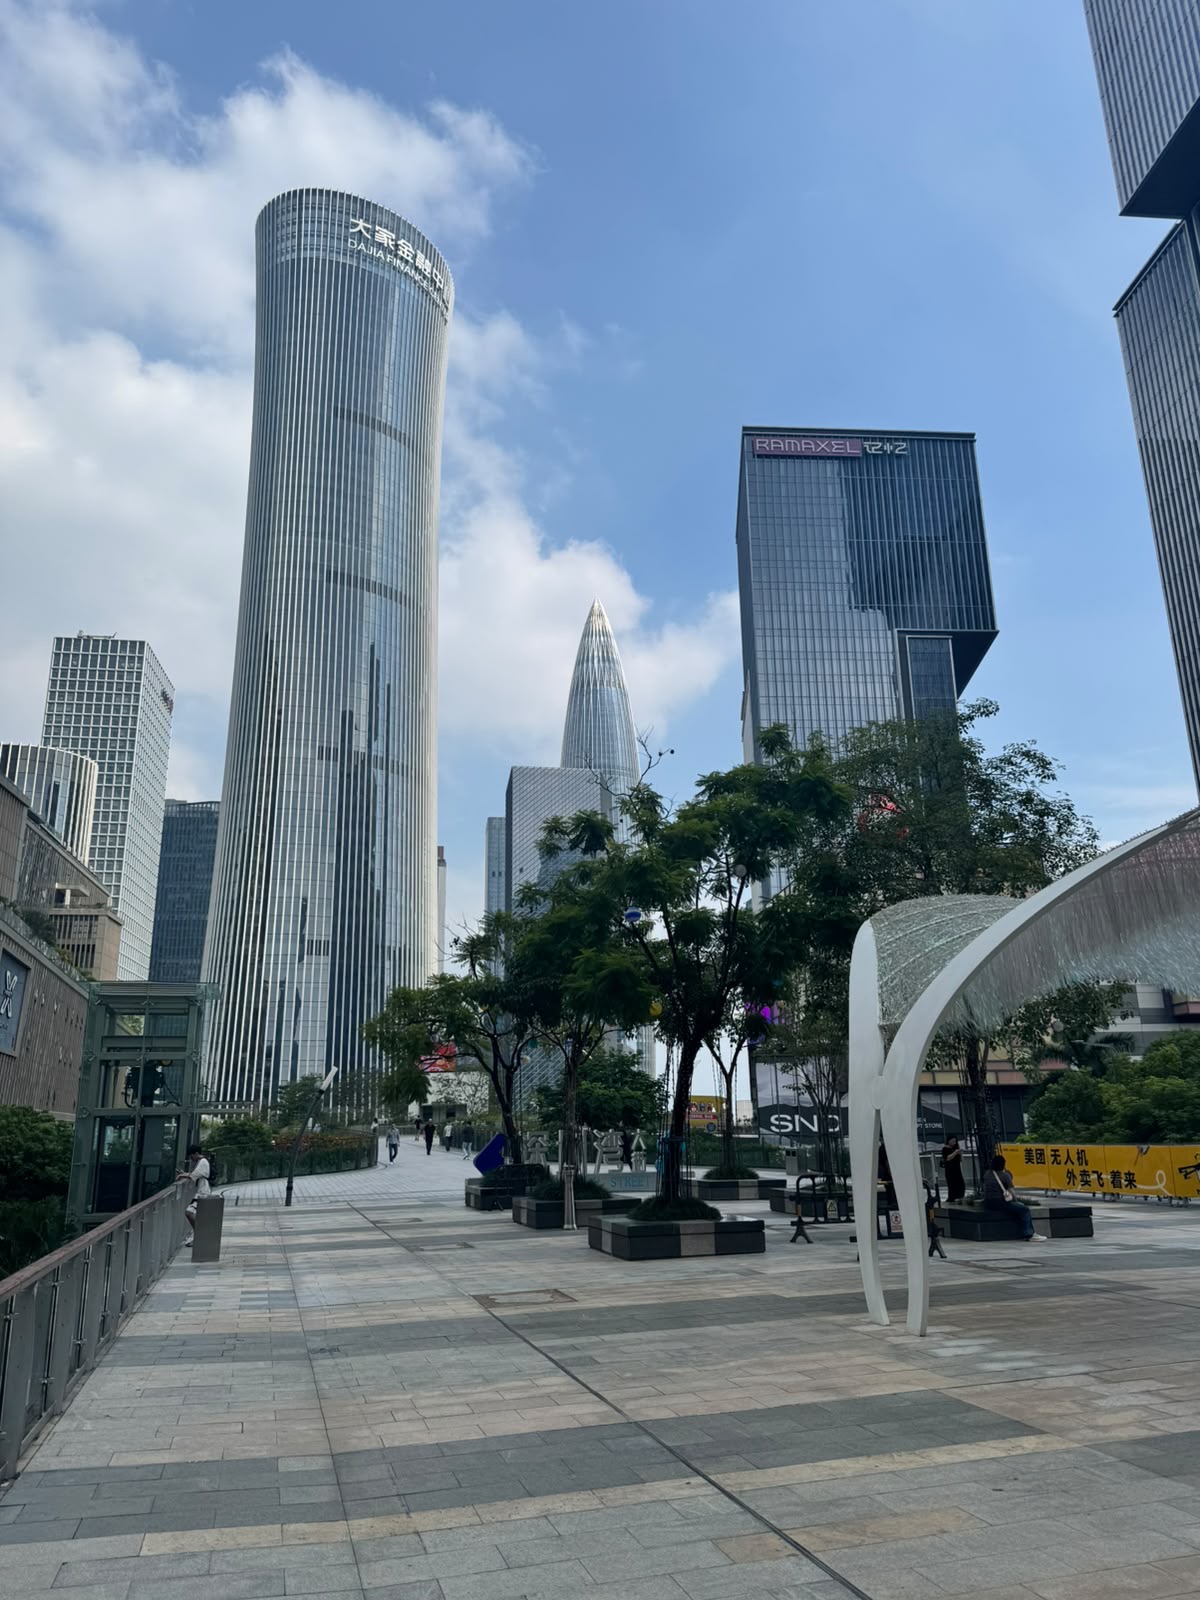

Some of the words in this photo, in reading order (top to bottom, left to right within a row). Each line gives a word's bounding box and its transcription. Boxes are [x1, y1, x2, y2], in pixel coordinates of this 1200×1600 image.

[348, 238, 385, 261] DAJIA
[755, 438, 861, 453] RAMAXEL
[1066, 1168, 1137, 1190] 外卖飞着来
